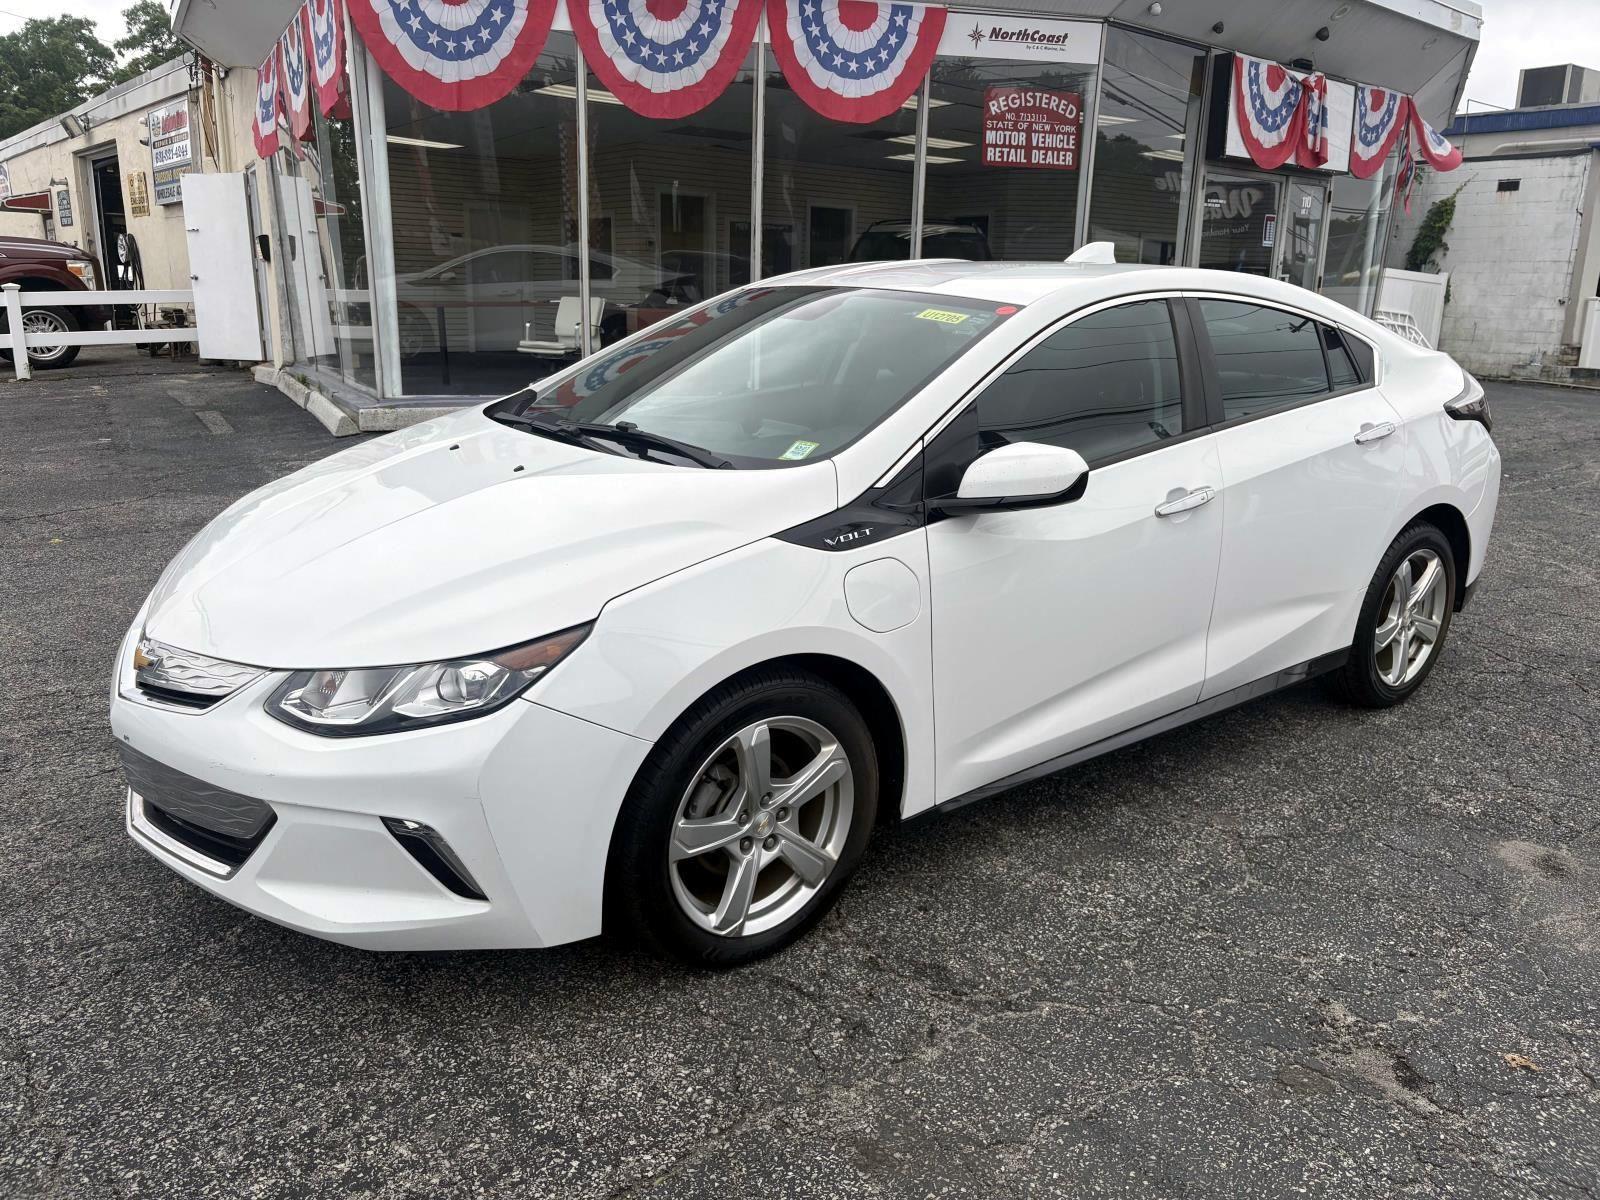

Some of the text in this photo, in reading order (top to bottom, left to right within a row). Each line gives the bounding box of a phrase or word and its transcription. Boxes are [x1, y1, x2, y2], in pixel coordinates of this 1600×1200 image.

[989, 26, 1069, 44] NorthCoast
[988, 92, 1077, 119] REGISTERED
[1005, 112, 1017, 121] NO.
[986, 121, 1077, 133] STATE OF NEW YORK
[986, 130, 1076, 149] MOTOR VEHICLE
[986, 147, 1073, 166] RETAIL DEALER
[823, 527, 874, 546] VOLT
